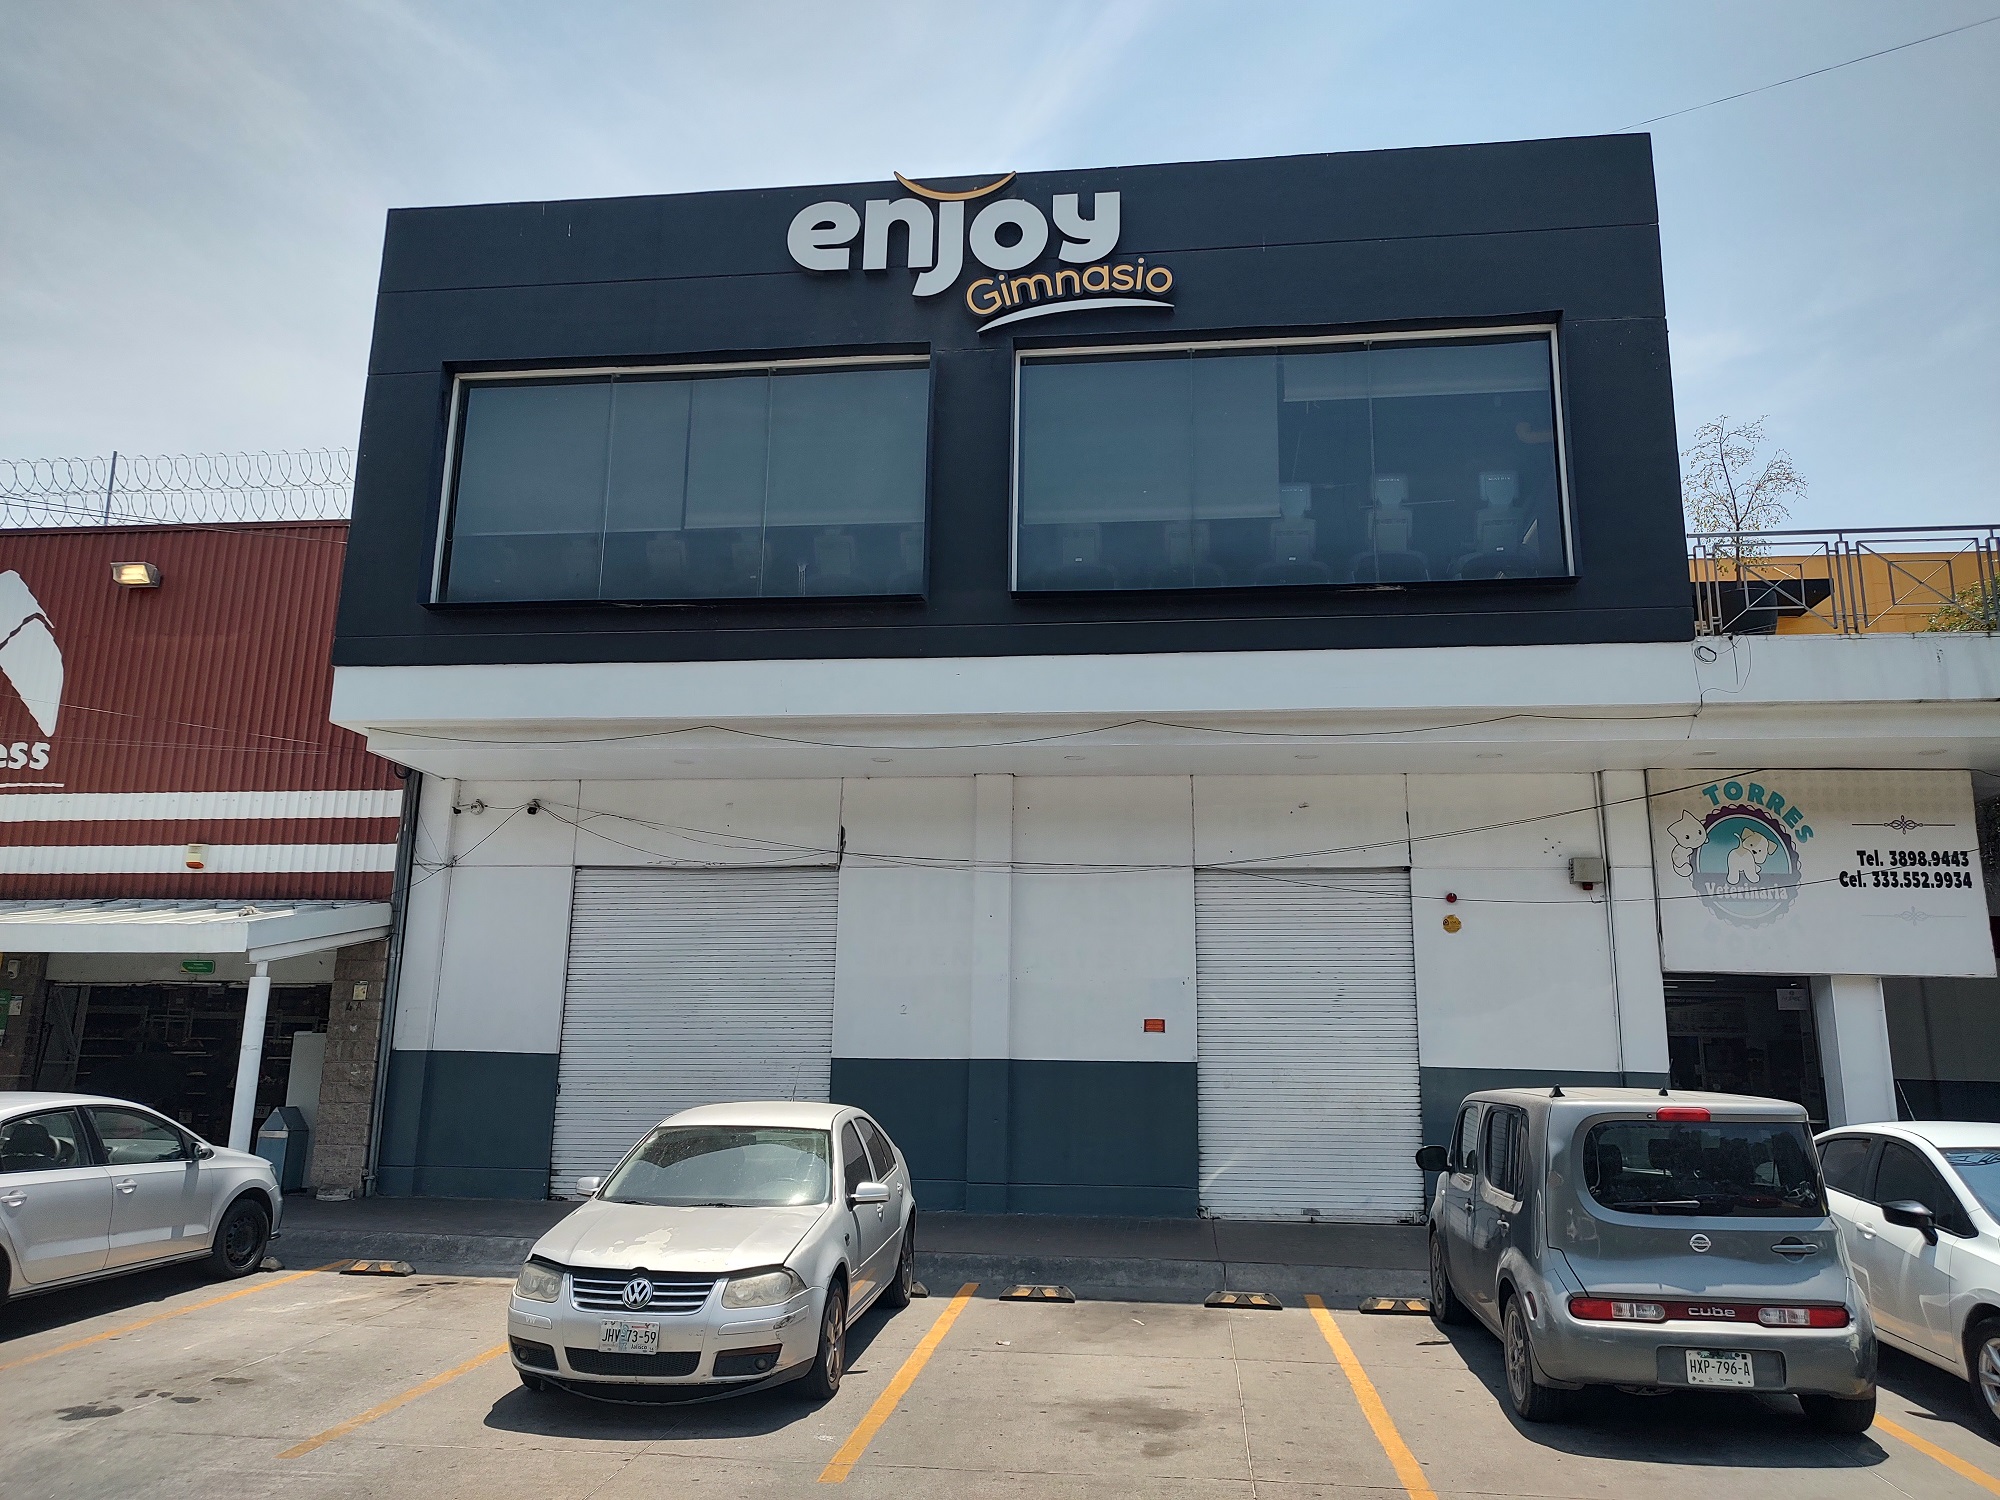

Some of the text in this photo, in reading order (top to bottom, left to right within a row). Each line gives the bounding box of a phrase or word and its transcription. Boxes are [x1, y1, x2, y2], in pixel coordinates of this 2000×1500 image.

[787, 191, 1121, 297] enjoy
[965, 257, 1174, 316] Gimnasio
[1701, 781, 1814, 844] TORRES
[1856, 849, 1970, 867] Tel. 3898.9443
[1839, 869, 1973, 889] Cel. 333.552.9934
[1704, 881, 1788, 900] Veterinaria
[1690, 1359, 1750, 1376] HXP-796-A
